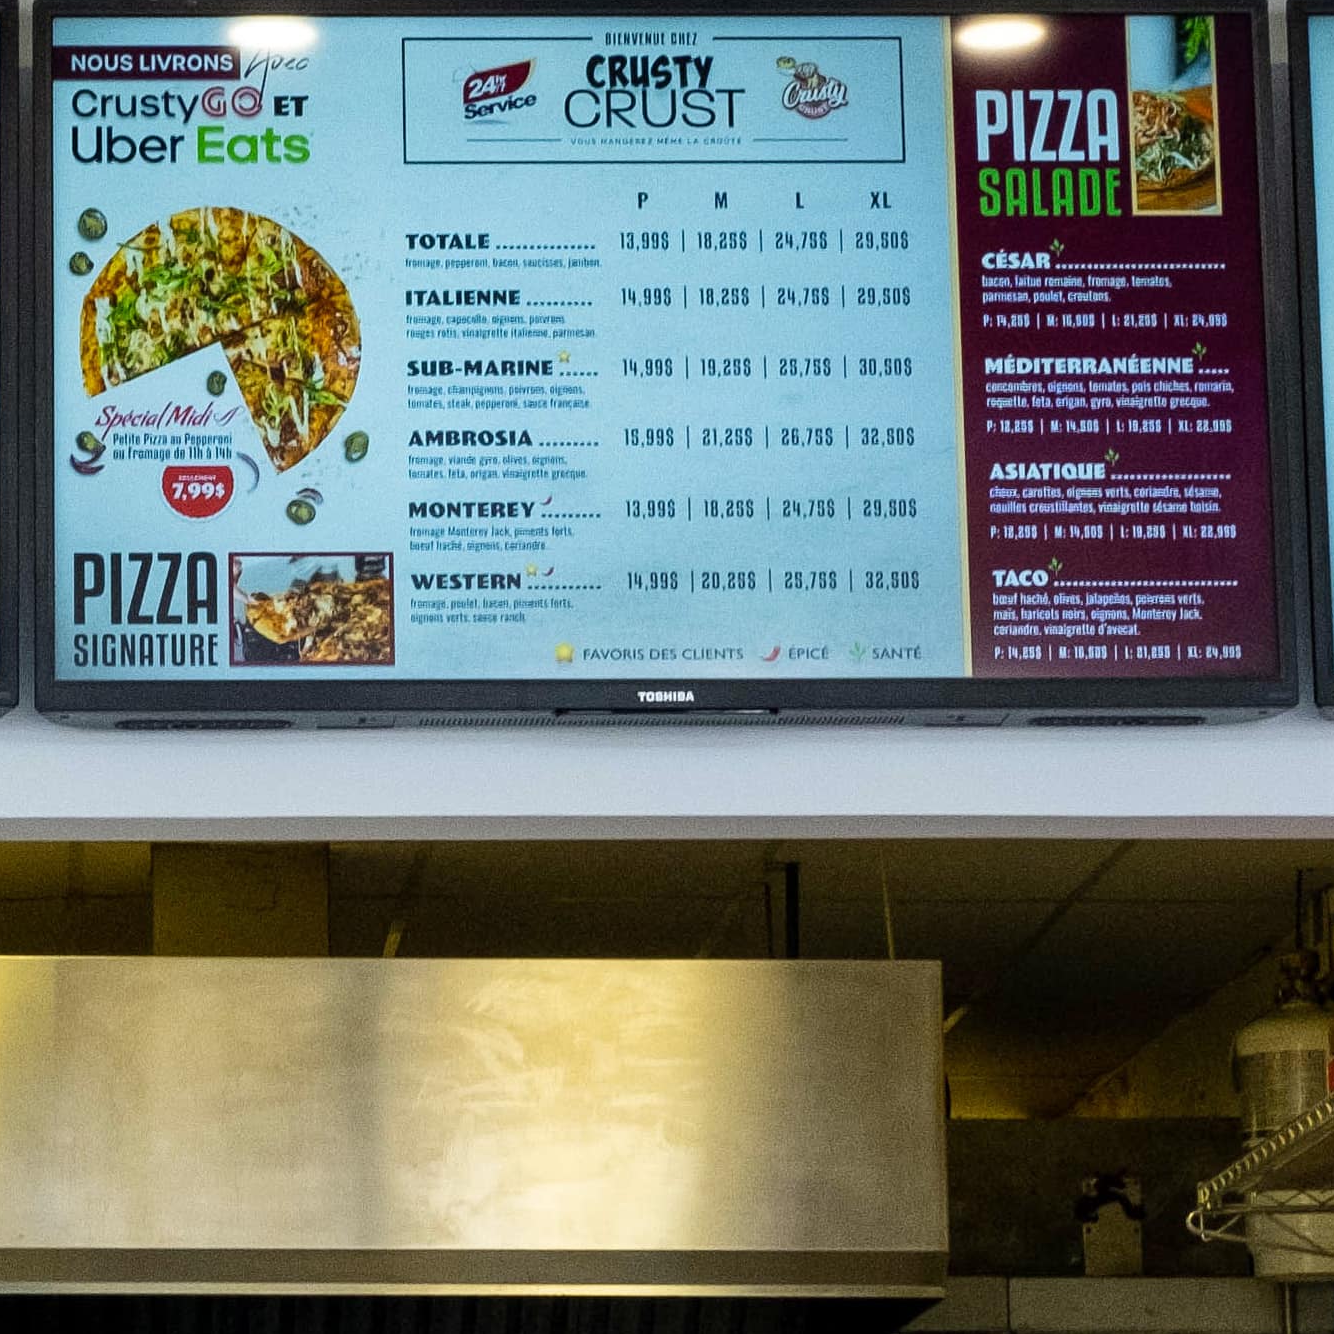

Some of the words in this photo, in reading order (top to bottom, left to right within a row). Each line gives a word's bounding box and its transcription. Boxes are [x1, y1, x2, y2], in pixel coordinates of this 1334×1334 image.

[71, 54, 133, 72] NOUS
[140, 54, 233, 72] LIVRONS
[585, 54, 713, 90] CRUSTY
[274, 96, 308, 117] ET
[464, 94, 537, 119] Service
[565, 88, 745, 128] CRUST
[976, 89, 1119, 161] PIZZA
[71, 126, 184, 163] Uber
[197, 126, 311, 163] Eats
[638, 192, 648, 209] P
[715, 192, 727, 209] M
[796, 192, 804, 209] L
[871, 192, 891, 209] XL
[979, 167, 1122, 216] SALADE
[406, 233, 490, 250] TOTALE
[982, 249, 1050, 269] CÉSAR
[406, 290, 520, 306] ITALIENNE
[407, 360, 553, 377] SUB-MARINE
[985, 354, 1193, 374] MÉDITERRANÉENNE
[113, 433, 140, 444] Petite
[144, 433, 167, 444] Pizza
[170, 436, 182, 444] au
[185, 433, 232, 447] Pepperoni
[408, 430, 532, 447] AMBROSIA
[989, 463, 1105, 480] ASIATIQUE
[172, 482, 225, 501] 7,99$
[408, 502, 535, 518] MONTEREY
[411, 573, 521, 590] WESTERN
[993, 569, 1048, 587] TACO
[74, 552, 217, 625] PIZZA
[74, 634, 218, 667] SIGNATURE
[583, 648, 645, 660] FAVORIS
[649, 648, 677, 660] DES
[682, 648, 744, 660] CLIENTS
[789, 645, 829, 660] ÉPICÉ
[872, 645, 921, 660] SANTÉ
[638, 691, 694, 702] TOSHIBA
